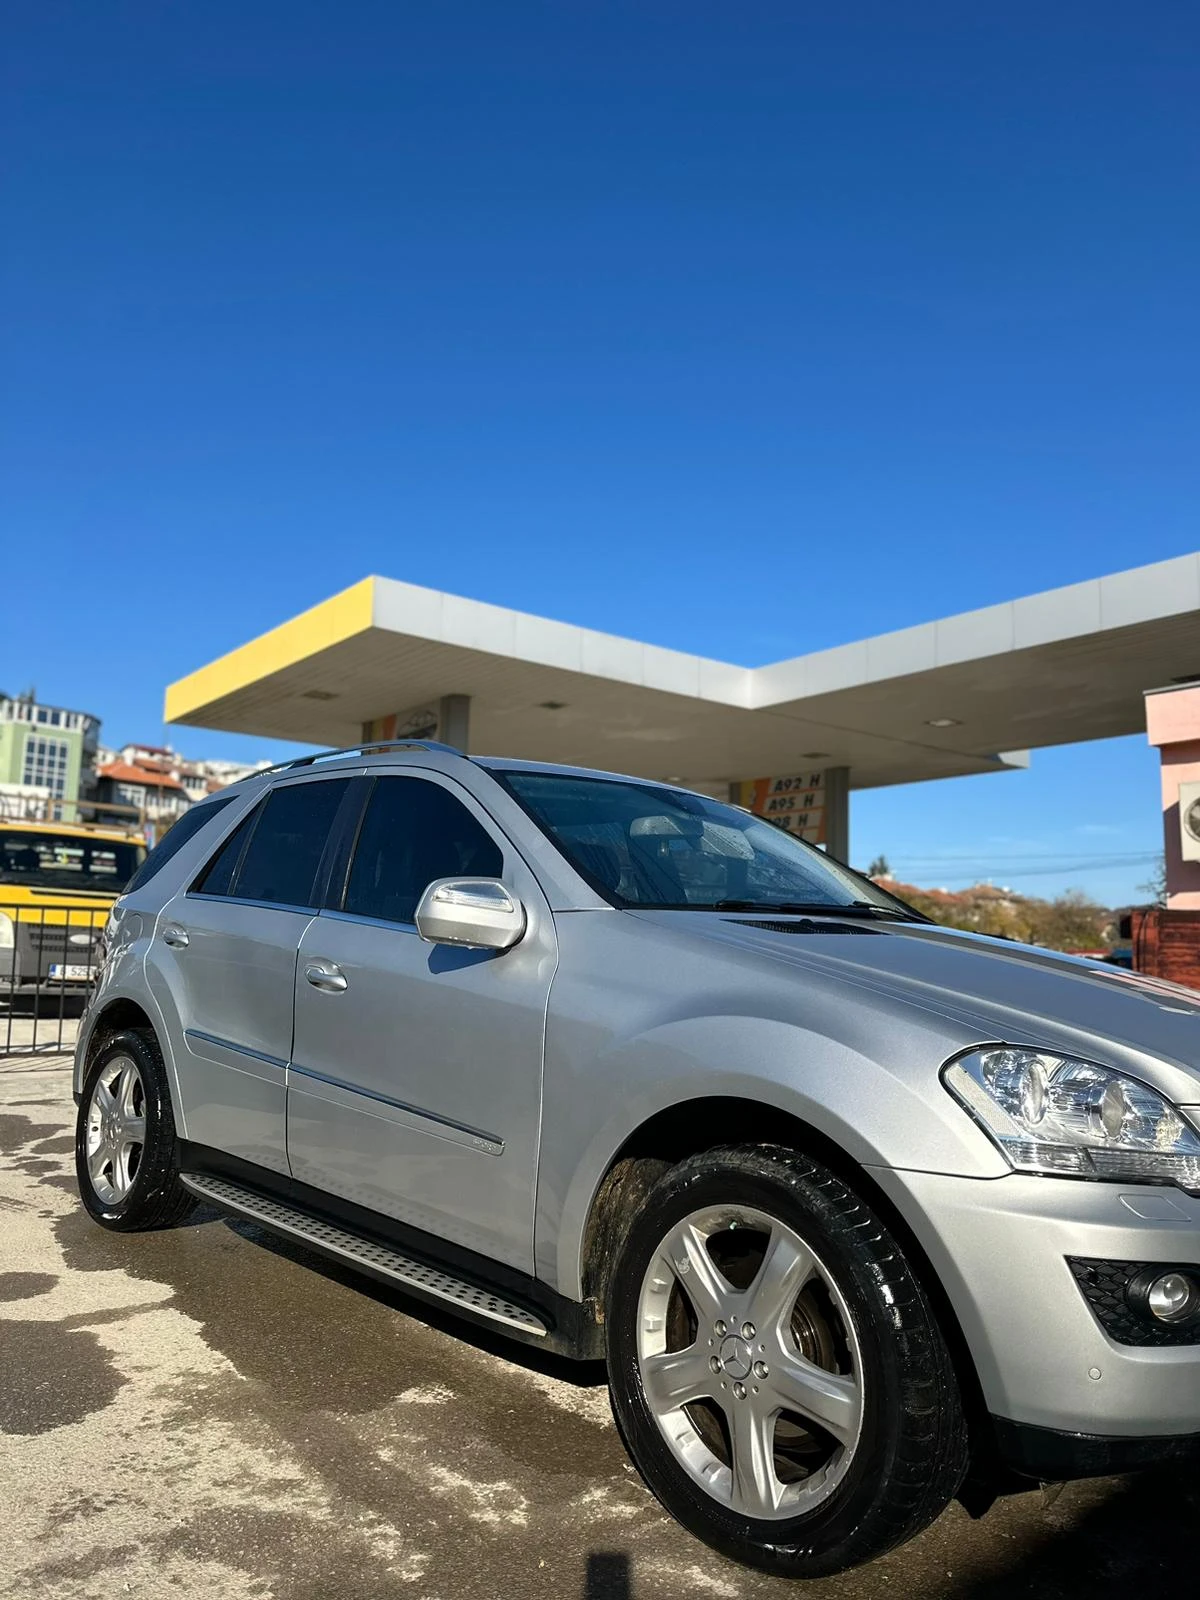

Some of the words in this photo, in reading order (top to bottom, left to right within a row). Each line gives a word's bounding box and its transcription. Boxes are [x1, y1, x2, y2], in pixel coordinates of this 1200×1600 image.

[774, 776, 802, 792] A92
[768, 796, 796, 810] A95
[768, 815, 792, 828] 98
